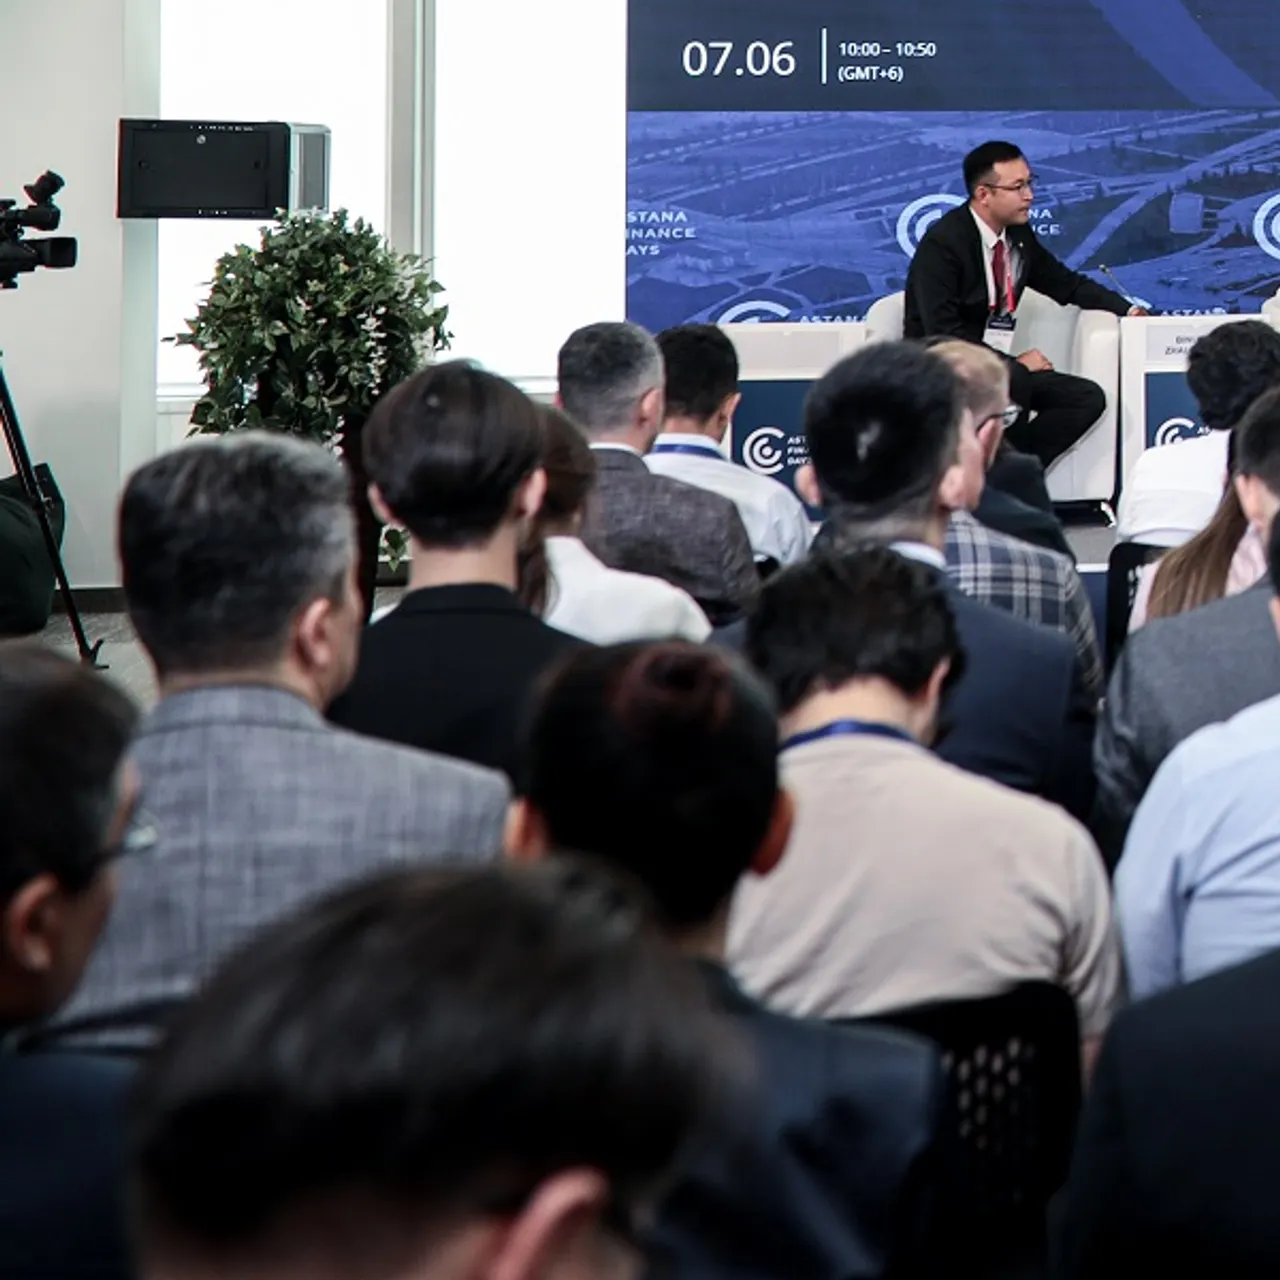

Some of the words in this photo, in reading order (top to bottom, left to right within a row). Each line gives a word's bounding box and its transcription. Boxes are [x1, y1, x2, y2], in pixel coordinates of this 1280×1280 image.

[838, 41, 880, 57] 10:00
[895, 41, 937, 57] 10:50
[682, 40, 796, 77] 07.06
[837, 64, 904, 84] (GMT+6)
[627, 211, 688, 222] STANA
[627, 245, 660, 255] AYS
